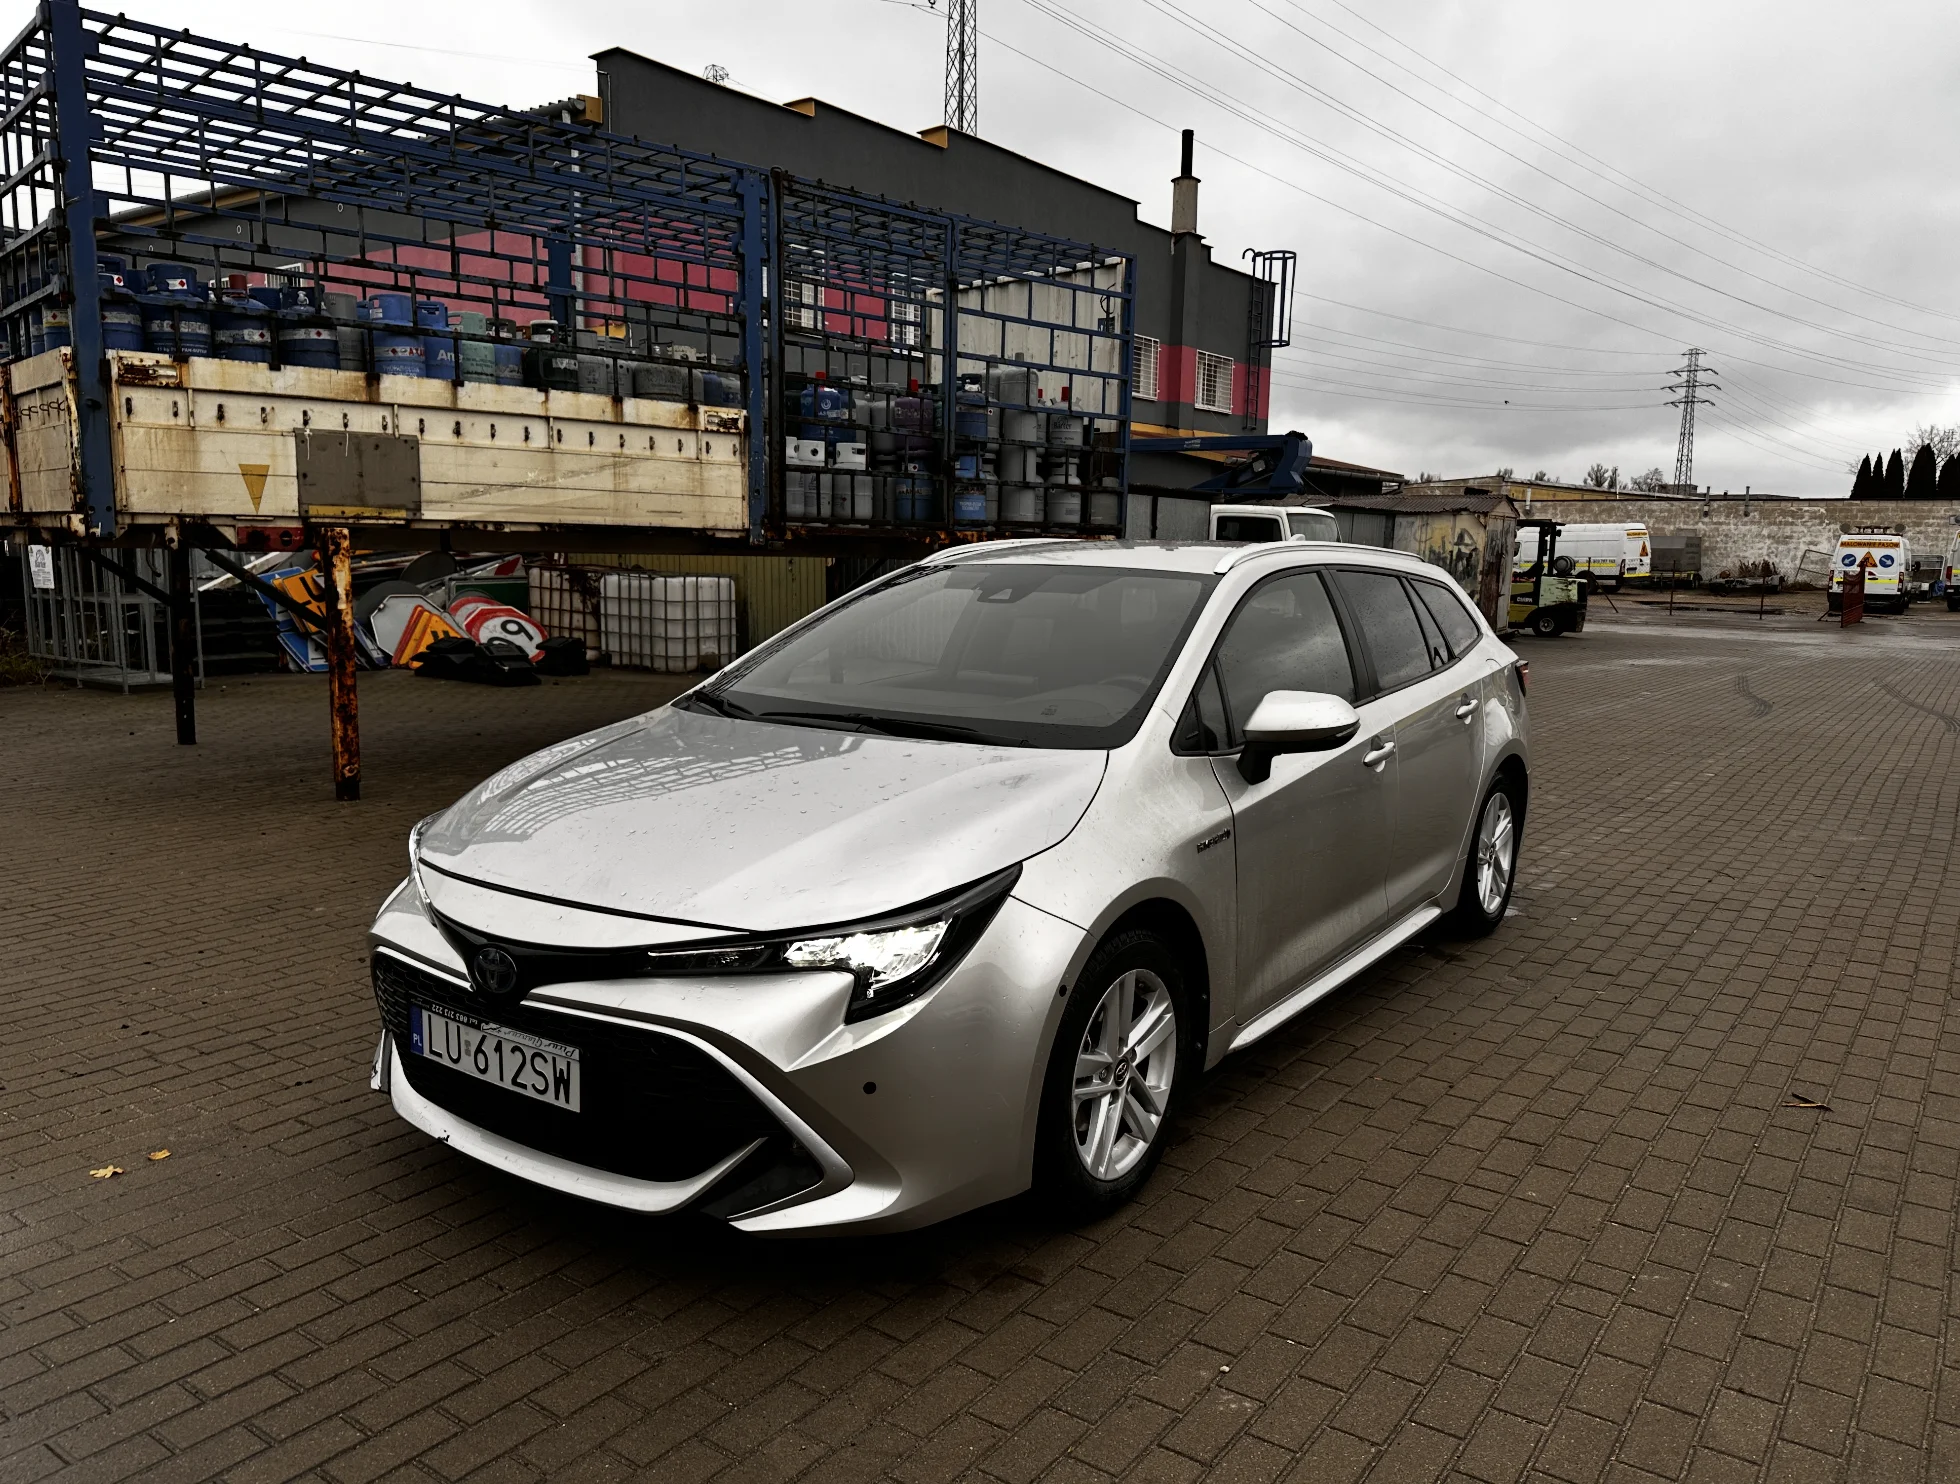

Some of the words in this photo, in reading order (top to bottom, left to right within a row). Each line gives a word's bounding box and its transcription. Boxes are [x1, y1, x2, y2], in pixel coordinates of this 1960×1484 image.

[413, 1033, 422, 1047] PL
[427, 1013, 462, 1064] LU
[473, 1034, 571, 1104] 612SW
